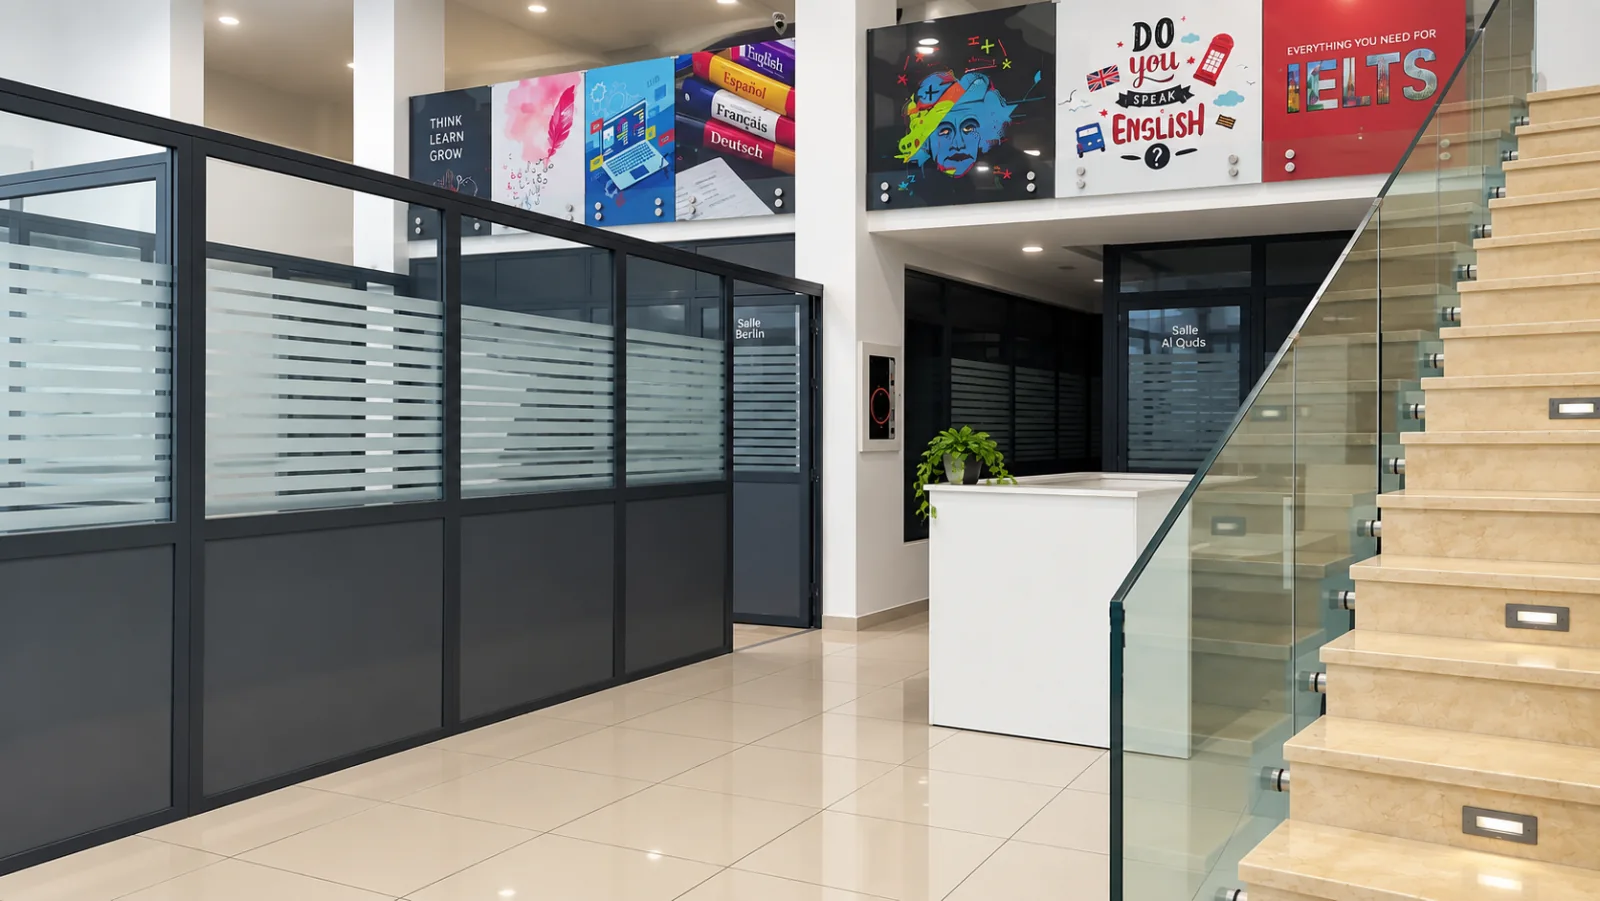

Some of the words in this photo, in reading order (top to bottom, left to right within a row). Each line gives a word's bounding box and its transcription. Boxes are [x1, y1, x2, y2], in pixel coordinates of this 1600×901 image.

[1132, 17, 1174, 52] DO
[1287, 40, 1352, 55] EVERYTHING
[1354, 36, 1377, 47] YOU
[1380, 32, 1410, 44] NEED
[1414, 29, 1437, 40] FOR
[1129, 51, 1180, 88] you
[723, 71, 767, 99] Español
[1287, 48, 1438, 114] IELTS
[1133, 90, 1176, 105] SPEAK
[430, 115, 462, 129] THINK
[716, 103, 768, 133] Français
[1112, 103, 1205, 145] ENGLISH
[430, 131, 464, 145] LEARN
[711, 131, 763, 159] Deutsch
[430, 148, 463, 162] GROW
[1152, 147, 1163, 167] ?
[737, 318, 761, 328] Salle
[1172, 325, 1199, 335] Salle
[736, 329, 765, 339] Berlin
[1161, 337, 1173, 348] Al
[1176, 337, 1206, 349] Quds
